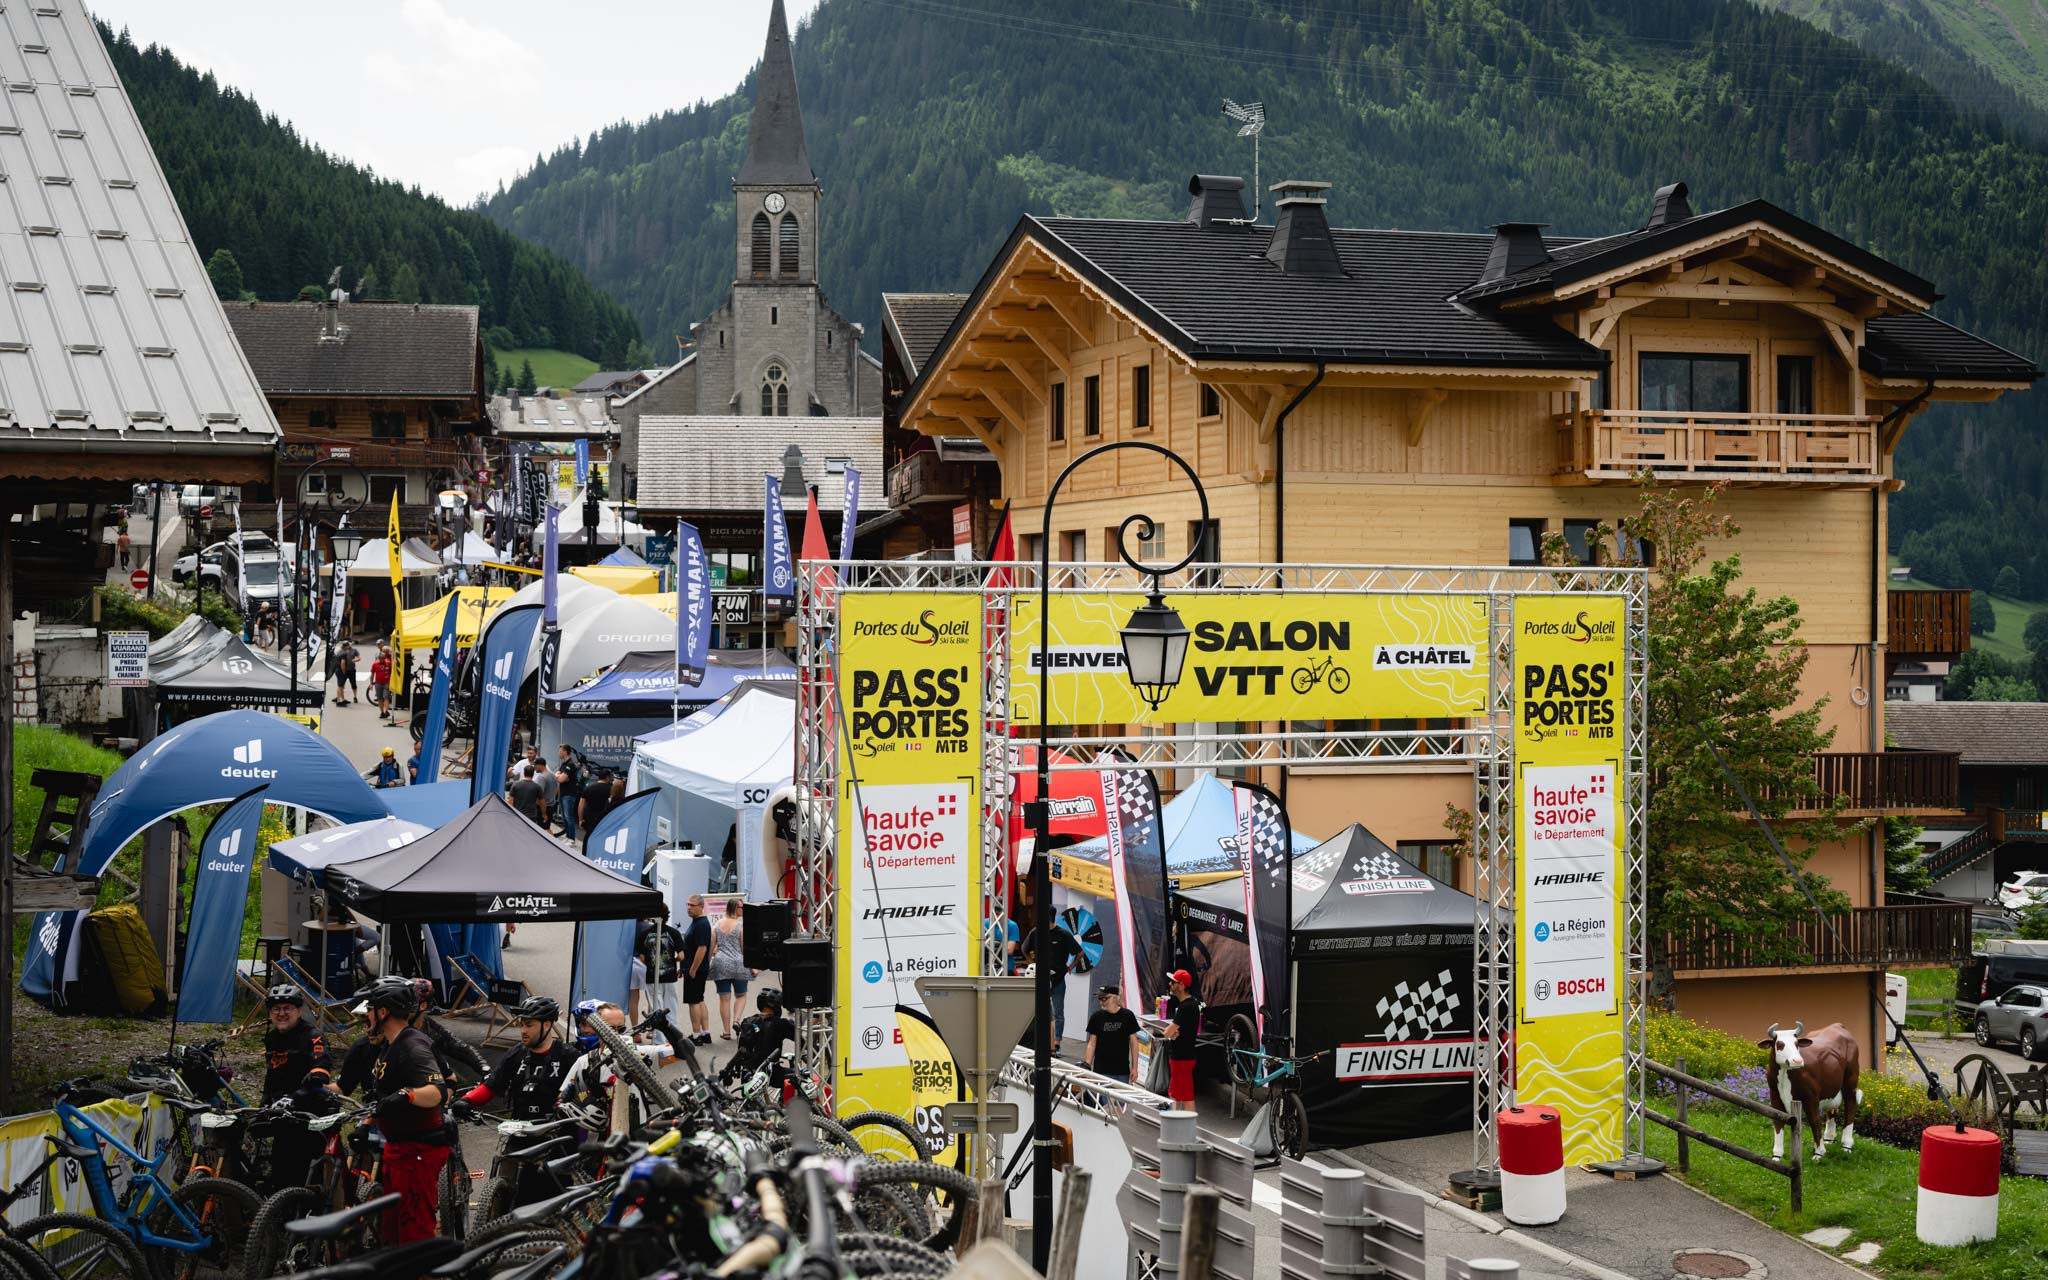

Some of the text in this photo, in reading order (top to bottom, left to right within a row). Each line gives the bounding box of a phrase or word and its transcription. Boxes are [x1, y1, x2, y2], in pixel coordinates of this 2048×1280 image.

[771, 486, 784, 565] YAMAHA
[688, 536, 702, 630] YAMAHA
[717, 596, 747, 610] FUN
[853, 610, 969, 646] Portes du Soleil
[1193, 621, 1350, 652] SALON
[1524, 612, 1615, 644] Portes du Soleil
[1031, 652, 1130, 667] BIENVEN
[1376, 647, 1471, 665] À CHÂTEL
[853, 666, 968, 708] PASS'
[1193, 665, 1284, 696] VTT
[1524, 661, 1614, 698] PASS'
[486, 681, 513, 700] deuter
[1524, 699, 1615, 726] PORTES
[853, 709, 969, 739] PORTES
[1534, 724, 1558, 742] Soleil
[1589, 727, 1614, 738] MTB
[865, 736, 896, 758] Soleil
[936, 740, 968, 753] MTB
[221, 766, 278, 779] deuter
[744, 789, 770, 804] SC
[1533, 784, 1588, 807] haute
[864, 805, 935, 831] haute
[1534, 807, 1596, 826] savoie
[864, 831, 944, 852] savoie
[1534, 828, 1605, 841] le Département
[208, 860, 245, 873] deuter
[593, 857, 635, 872] deuter
[864, 854, 955, 869] le Département
[1349, 880, 1428, 892] FINISH LINE
[1534, 871, 1605, 886] HAIBIKE
[506, 895, 557, 908] CHÂTEL
[863, 904, 956, 920] HAIBIKE
[1228, 919, 1244, 933] LAVEZ
[1553, 918, 1605, 932] La Région
[1373, 936, 1393, 948] DES
[1429, 935, 1442, 945] EN
[887, 957, 957, 973] La Région
[1558, 978, 1605, 996] BOSCH
[1347, 1048, 1425, 1073] FINISH
